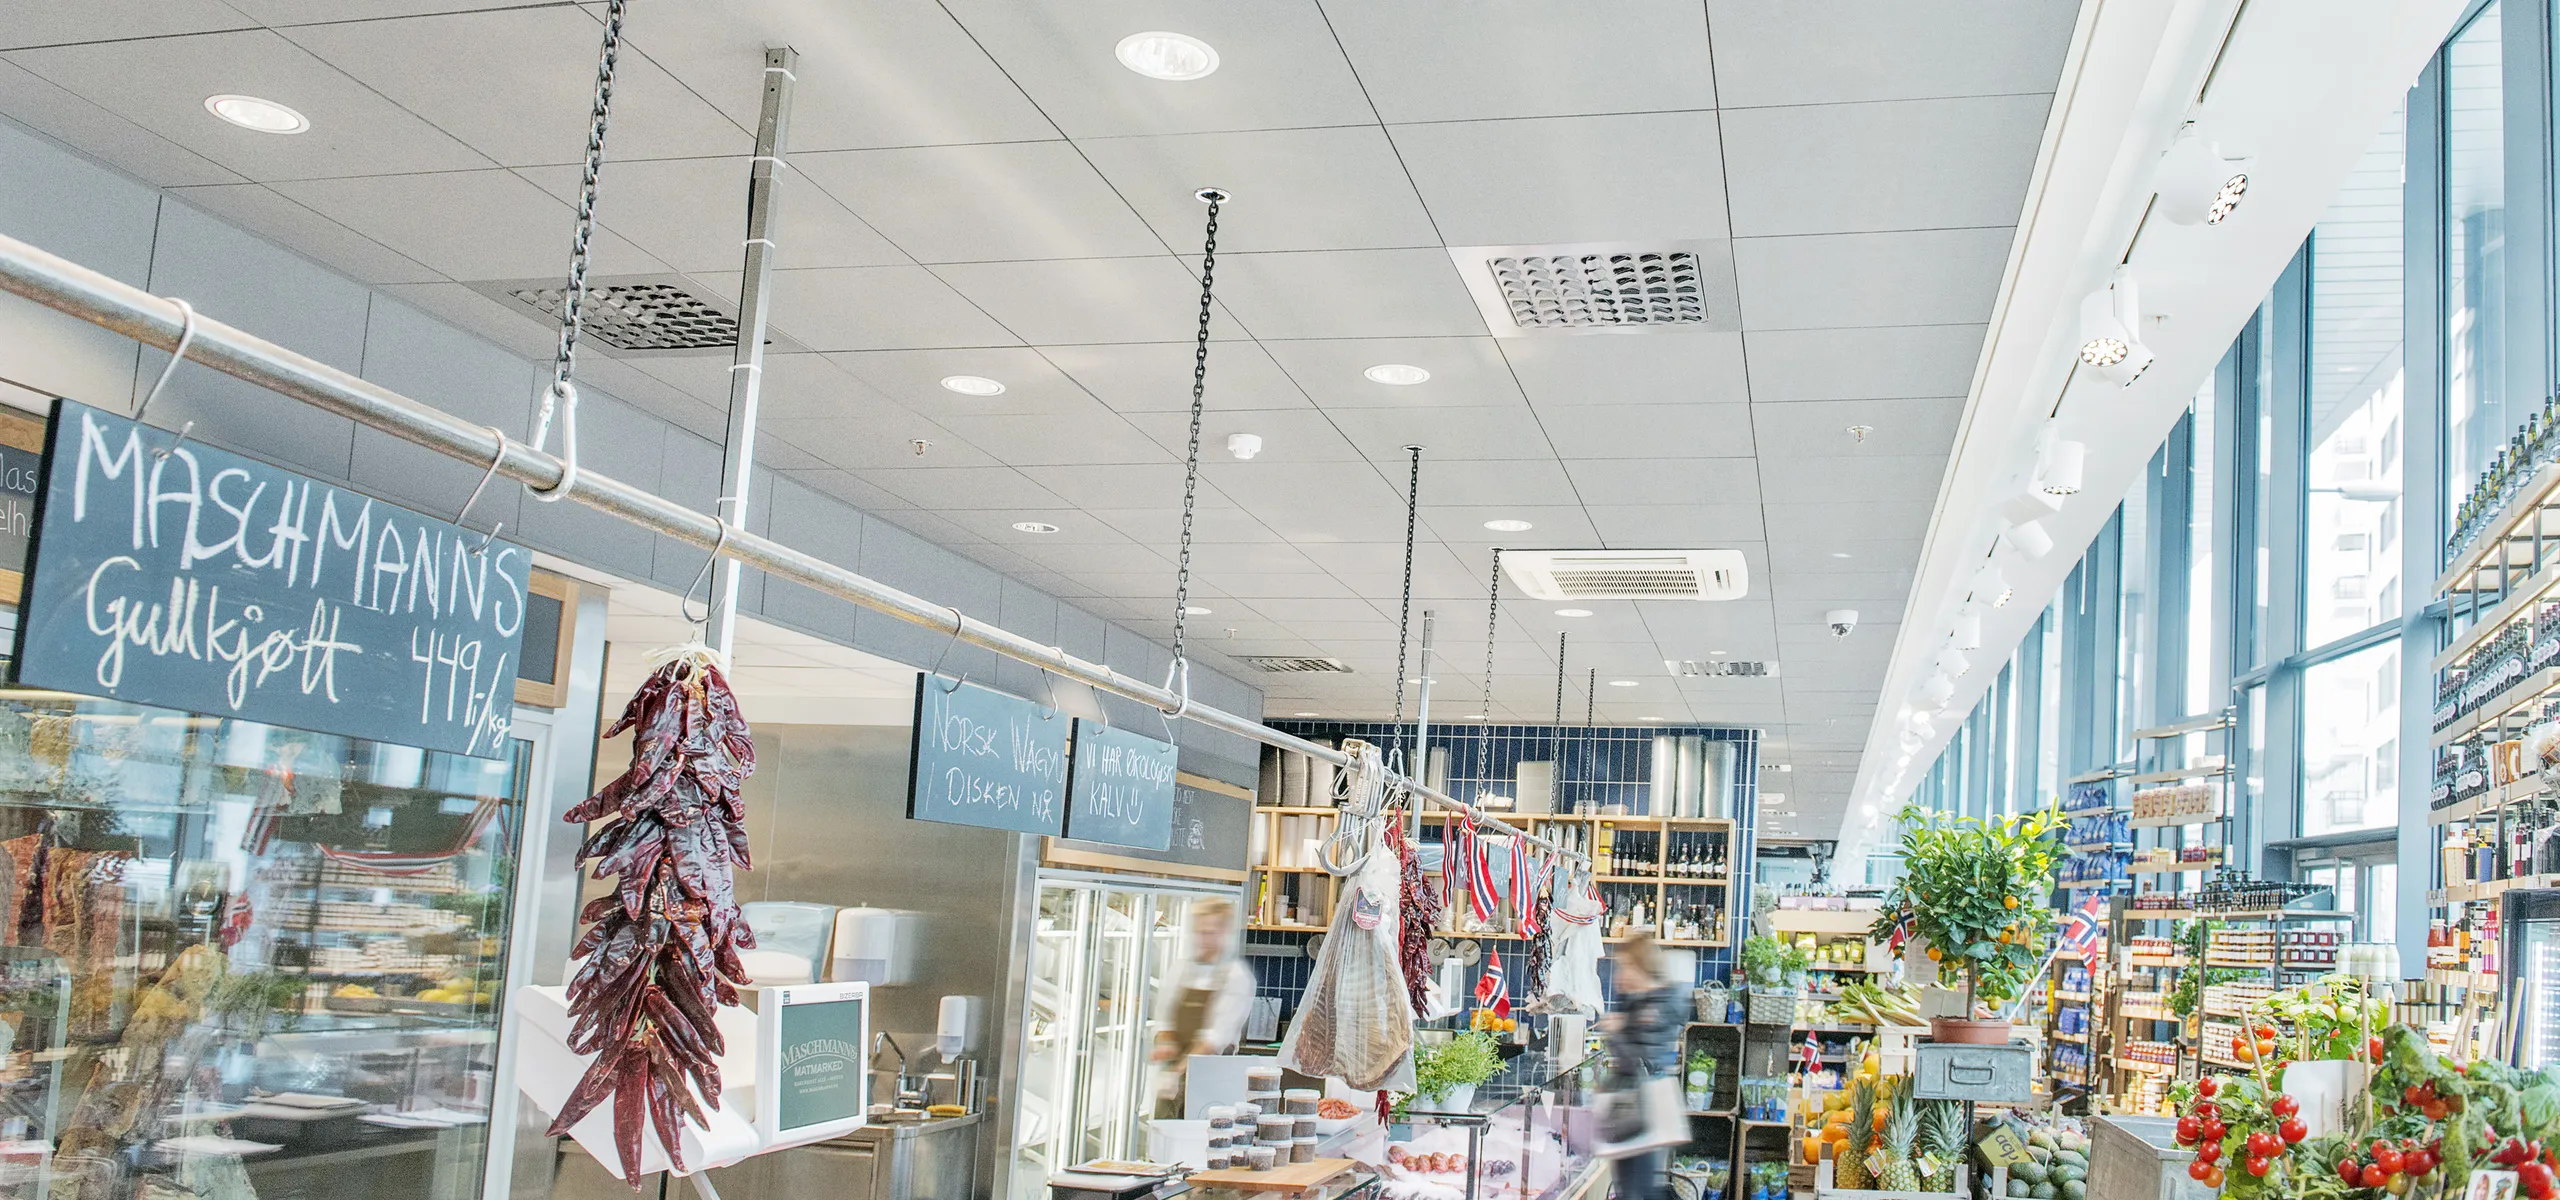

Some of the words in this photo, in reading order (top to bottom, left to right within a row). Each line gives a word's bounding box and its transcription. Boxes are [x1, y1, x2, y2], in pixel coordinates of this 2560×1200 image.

[75, 410, 523, 637] MASCHMANNS
[87, 556, 362, 711] Gullkjøtt
[932, 690, 999, 758] NORSK
[1102, 745, 1122, 777] HAR
[946, 766, 1021, 811] DISKEN
[1089, 780, 1124, 819] KALV
[781, 1039, 858, 1069] MASCHMANNS
[794, 1060, 844, 1077] MATMARKED
